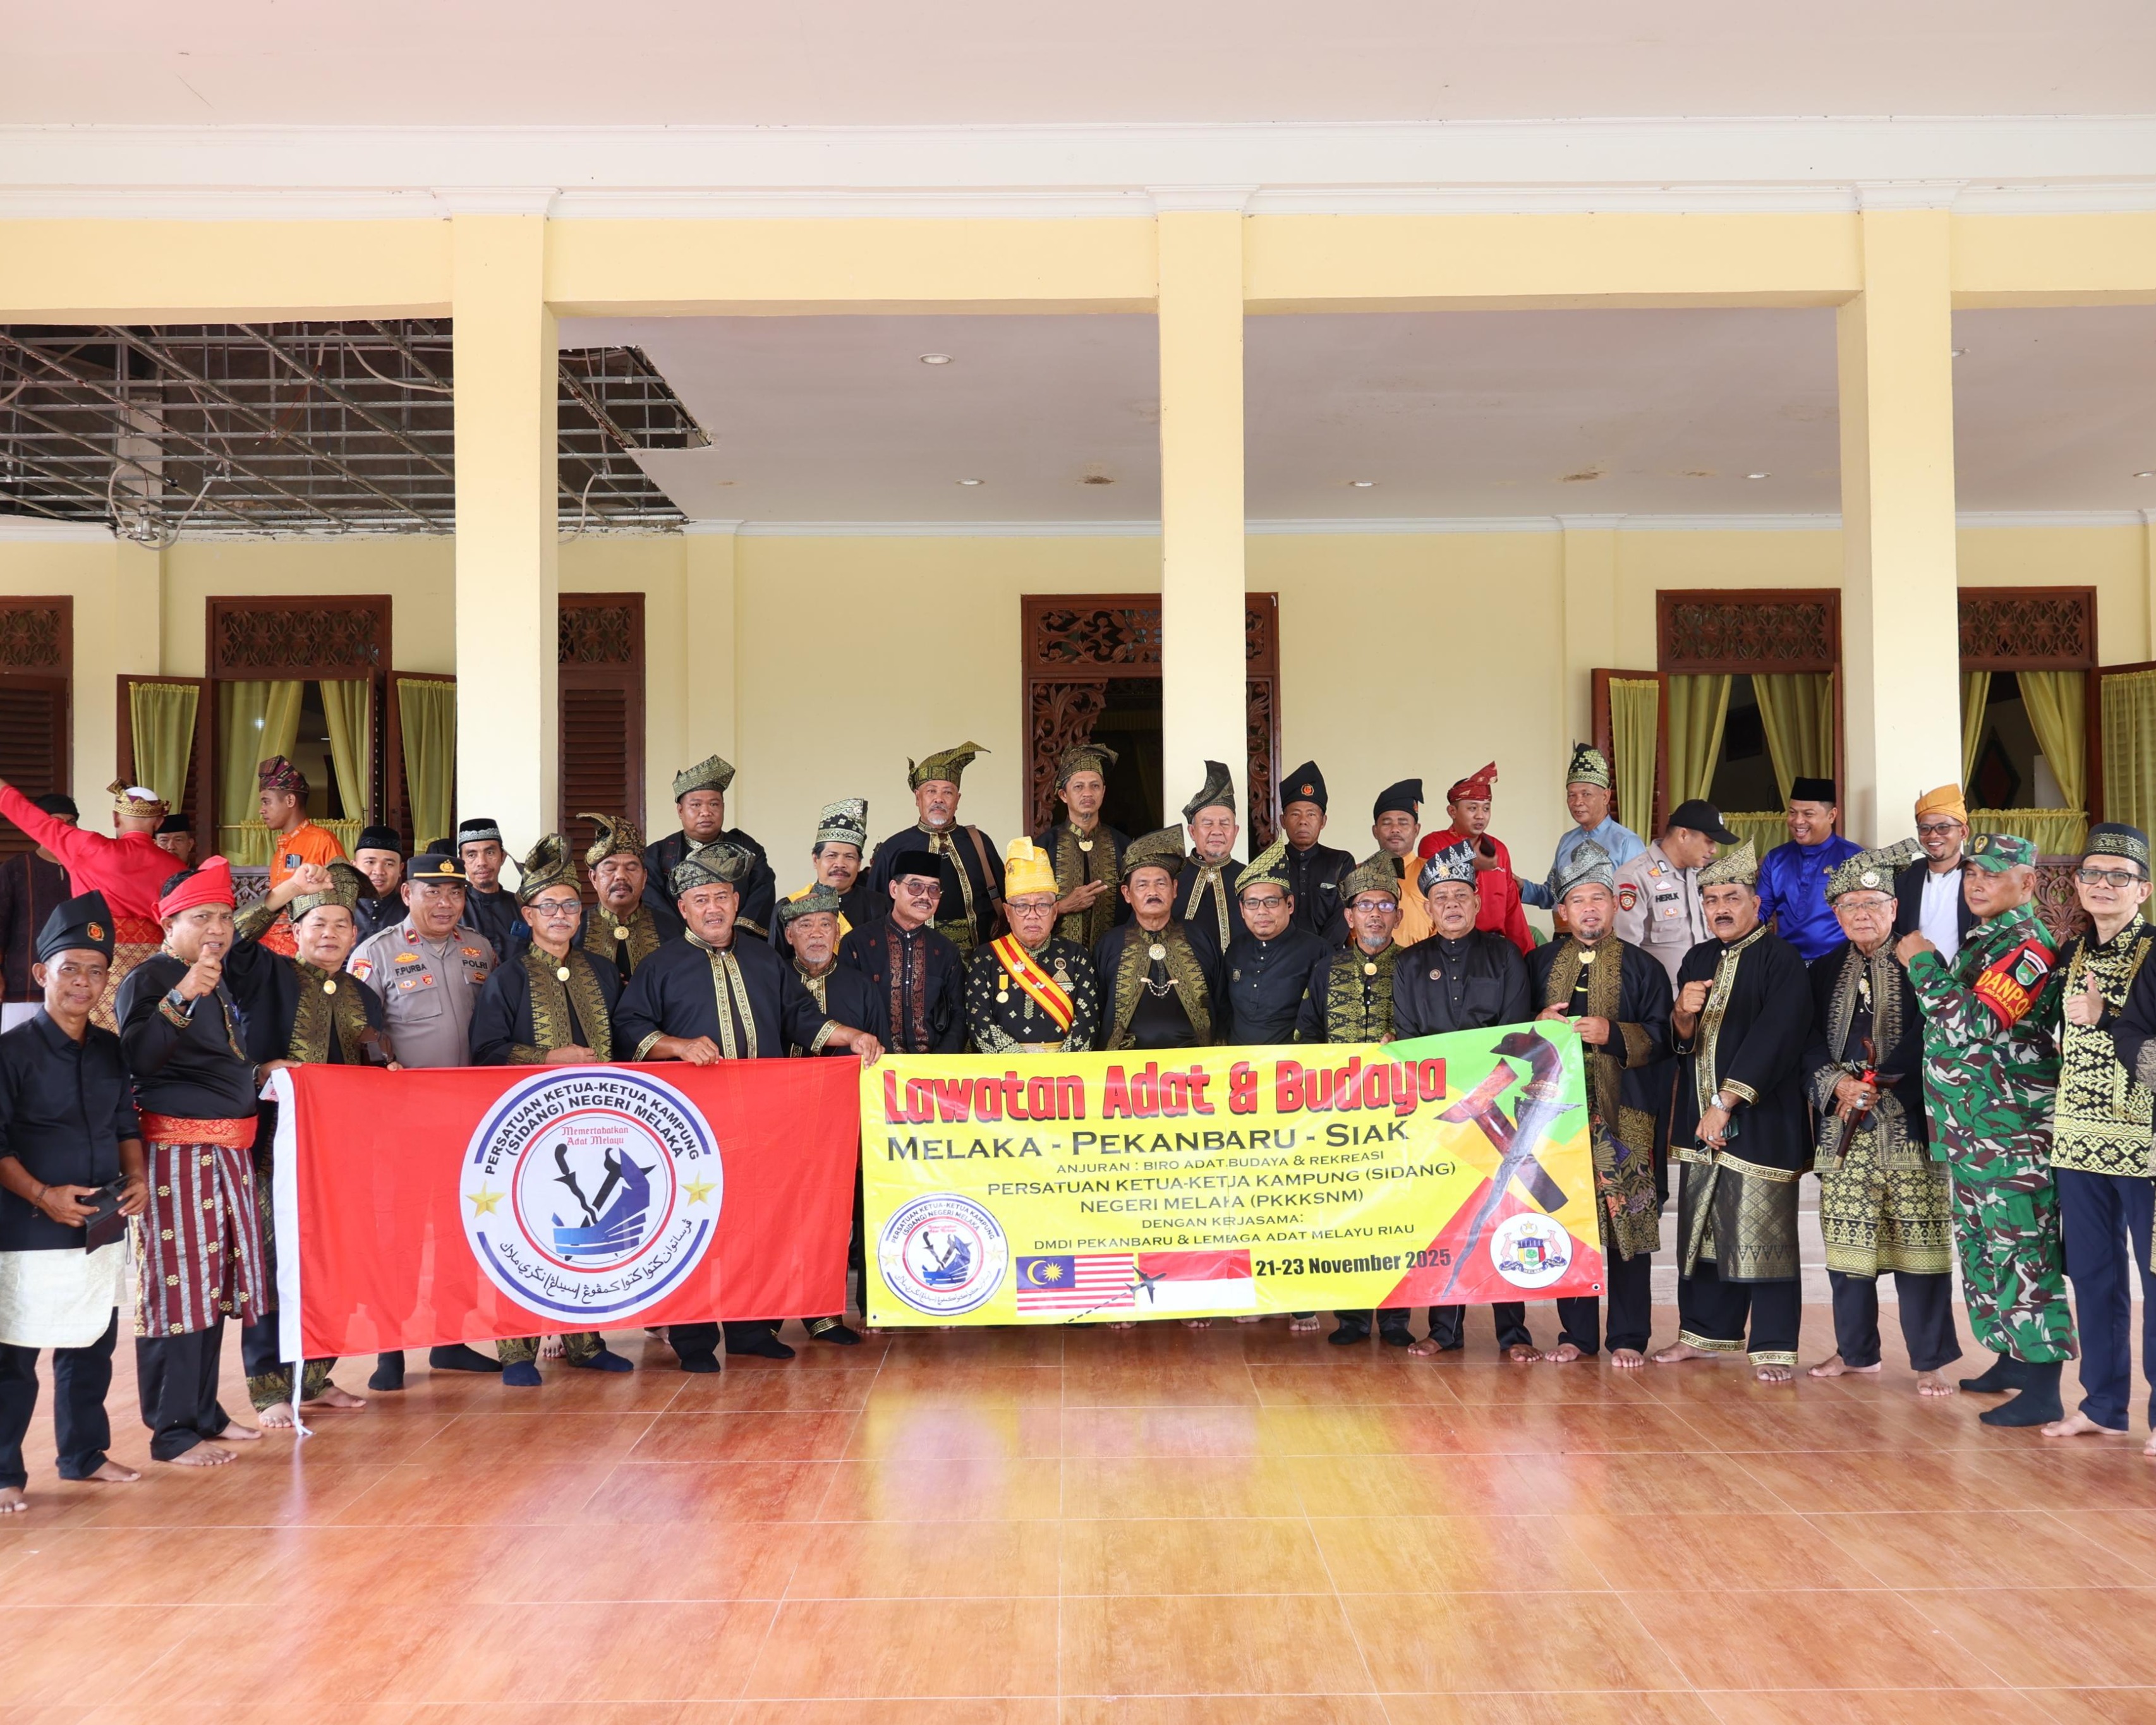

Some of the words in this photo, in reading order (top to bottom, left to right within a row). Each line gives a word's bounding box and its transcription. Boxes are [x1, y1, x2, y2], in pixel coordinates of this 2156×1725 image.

[395, 964, 427, 976] F.PURBA
[462, 959, 488, 969] POLRI
[883, 1070, 1086, 1124] Lawatan
[1103, 1062, 1215, 1119] Adat
[1229, 1061, 1257, 1115] &
[1276, 1056, 1446, 1117] Budaya
[485, 1098, 542, 1175] PERSATUAN
[543, 1082, 647, 1103] KETUA-KETUA
[650, 1099, 699, 1160] KAMPUNG
[506, 1101, 564, 1156] (SIDANG)
[568, 1094, 631, 1111] NEGERI
[634, 1105, 684, 1158] MELAKA
[567, 1137, 588, 1146] Adat
[591, 1135, 624, 1145] Melayu
[1057, 1162, 1130, 1173] ANJURAN
[1144, 1160, 1179, 1171] BIRO
[1293, 1155, 1305, 1166] &
[1310, 1150, 1384, 1165] REKREASI
[988, 1180, 1110, 1195] PERSATUAN
[1256, 1170, 1359, 1187] KAMPUNG
[1366, 1161, 1456, 1181] (SIDANG)
[1081, 1199, 1158, 1213] NEGERI
[1251, 1189, 1364, 1208] (PKKKSNM)
[892, 1210, 919, 1244] PERSATUAN
[919, 1202, 969, 1213] KETUA-KETUA
[969, 1211, 995, 1240] KAMPUNG
[903, 1214, 927, 1235] (SIDANG)
[928, 1209, 954, 1218] NEGERI
[955, 1211, 979, 1231] MELAKA
[1142, 1218, 1207, 1228] DENGAN
[1034, 1239, 1072, 1250] DMDI
[1077, 1237, 1173, 1248] PEKANBARU
[1177, 1234, 1189, 1245] &
[1266, 1231, 1307, 1242] ADAT
[1312, 1227, 1374, 1240] MELAYU
[1378, 1225, 1415, 1235] RIAU
[1256, 1258, 1305, 1276] 21-23
[1309, 1254, 1401, 1274] November
[1405, 1249, 1451, 1269] 2025
